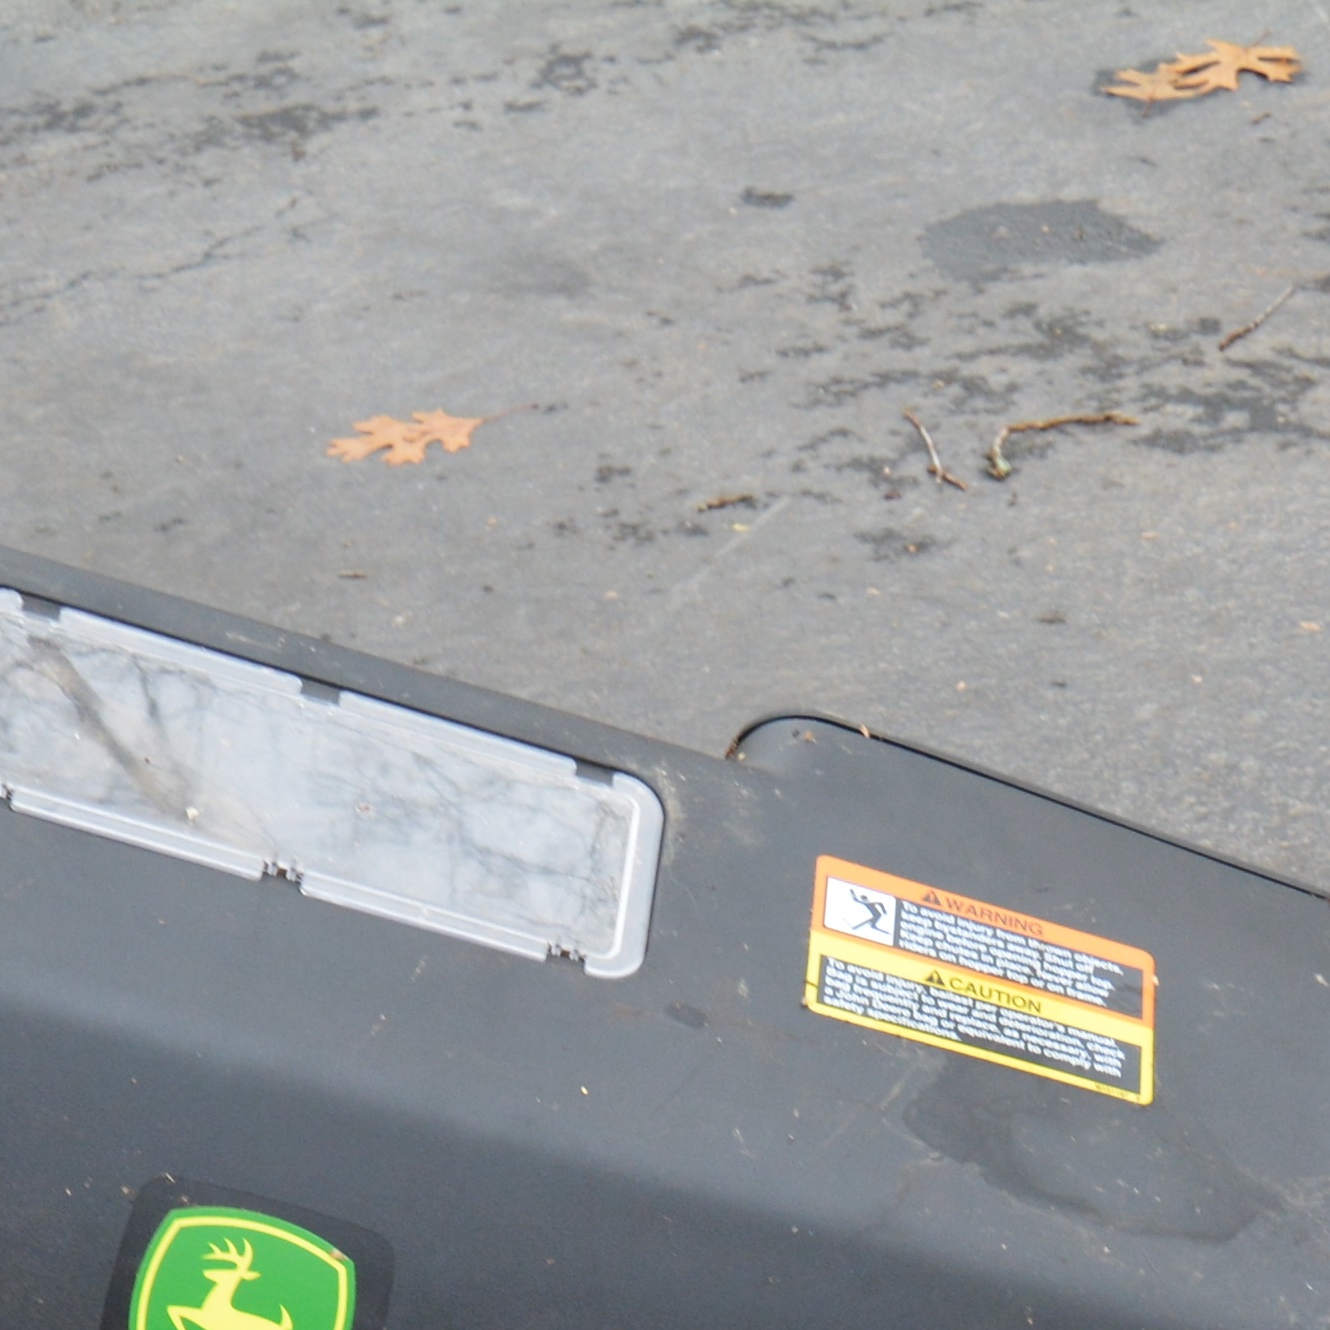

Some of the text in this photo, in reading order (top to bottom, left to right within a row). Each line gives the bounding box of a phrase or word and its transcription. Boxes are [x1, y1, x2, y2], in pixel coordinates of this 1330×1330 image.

[900, 910, 932, 929] keep
[933, 919, 1004, 949] bystanders
[1043, 951, 1073, 969] Shut
[1075, 960, 1093, 975] off
[901, 899, 1124, 975] To avoid injury from thrown objects,
[946, 897, 1043, 936] WARNING
[898, 938, 937, 958] riders
[938, 950, 957, 964] on
[958, 955, 1005, 979] hopper
[1006, 969, 1028, 985] top
[1030, 977, 1044, 989] or
[1046, 981, 1064, 994] on
[899, 920, 944, 942] engine
[945, 932, 987, 953] before
[988, 945, 1041, 970] opening
[1042, 961, 1088, 984] hopper
[899, 928, 933, 949] Keep
[934, 939, 978, 960] chutes
[980, 952, 993, 965] in
[1035, 968, 1073, 987] Never
[1075, 979, 1109, 998] allow
[823, 994, 864, 1016] safety
[824, 975, 851, 992] bag
[852, 983, 920, 1012] frequently
[921, 1003, 947, 1018] and
[1002, 1026, 1019, 1039] as
[1021, 1031, 1091, 1062] necessary,
[1093, 1052, 1121, 1068] with
[825, 965, 853, 983] Bag
[854, 974, 868, 986] is
[869, 978, 920, 1002] subject
[920, 993, 935, 1006] to
[936, 998, 970, 1016] wear
[971, 1008, 997, 1023] and
[826, 956, 845, 970] To
[846, 962, 884, 981] avoid
[885, 973, 927, 995] injury,
[929, 986, 973, 1007] ballast
[975, 1000, 997, 1015] per
[999, 1006, 1065, 1034] operator's
[949, 976, 1041, 1014] CAUTION
[824, 985, 1121, 1078] a John Deere bag or equivalent to comply with
